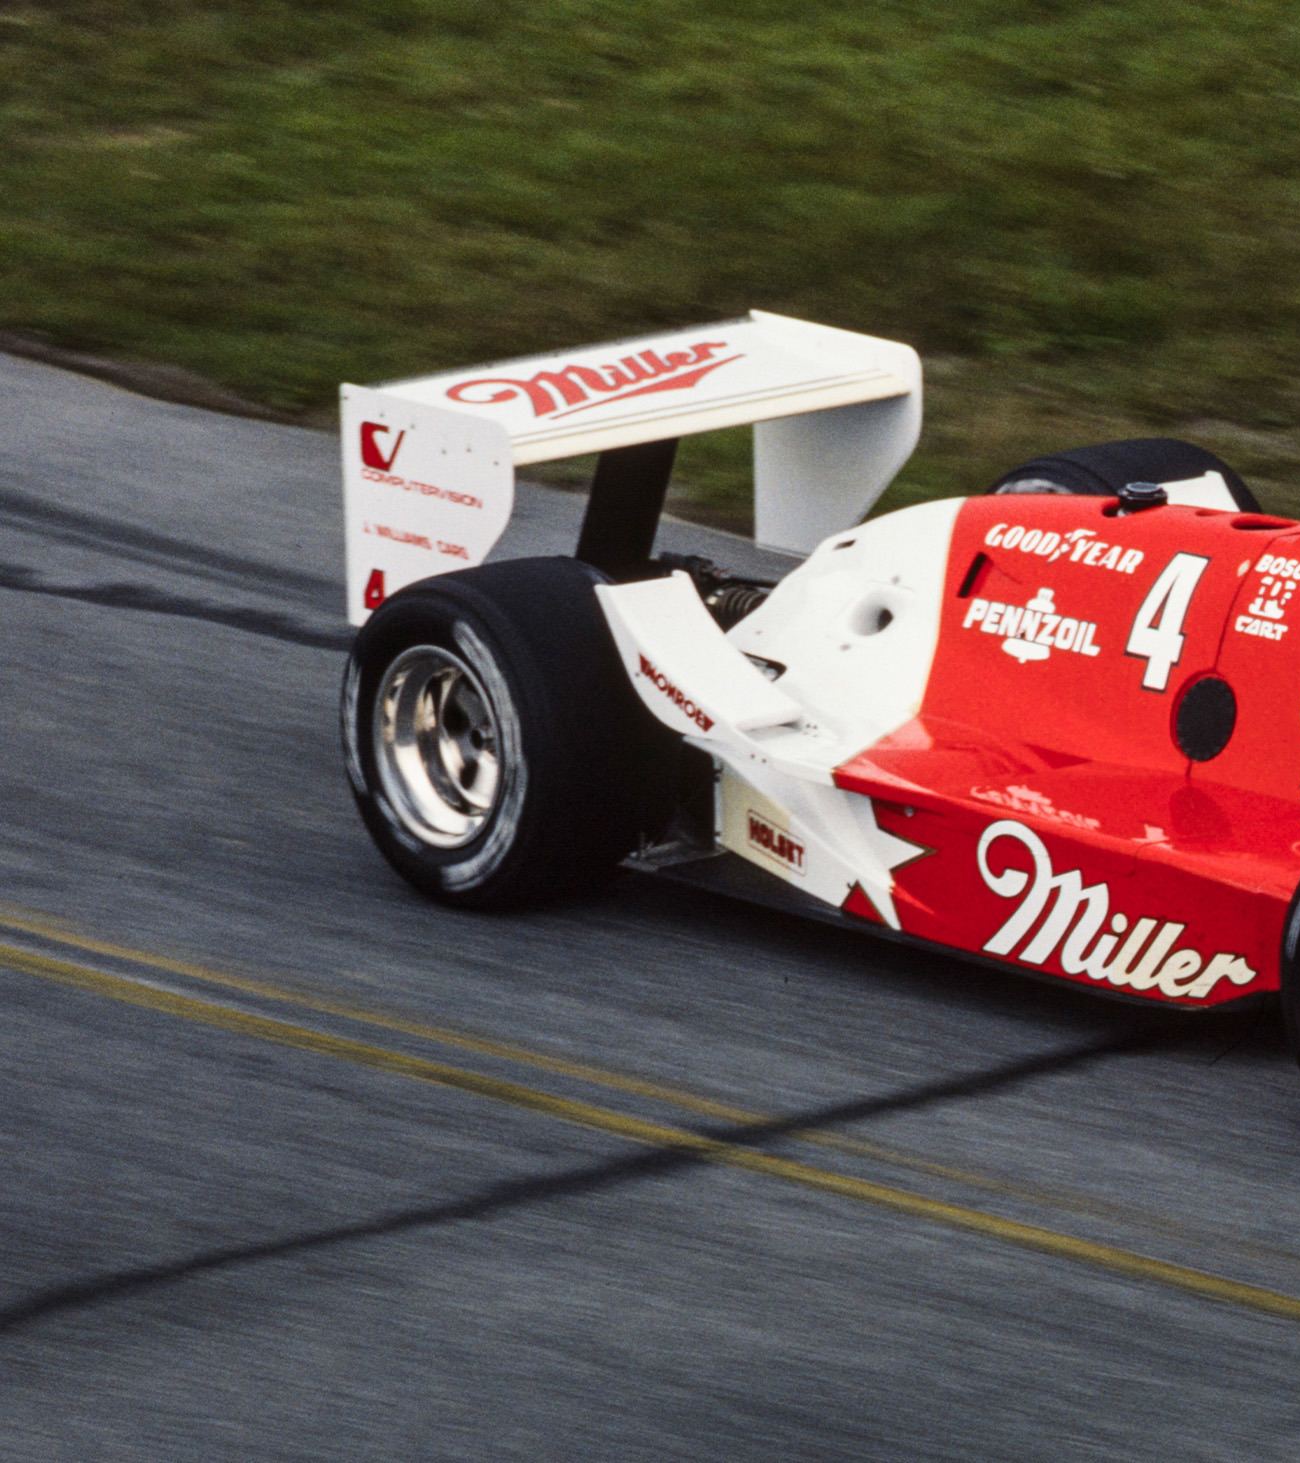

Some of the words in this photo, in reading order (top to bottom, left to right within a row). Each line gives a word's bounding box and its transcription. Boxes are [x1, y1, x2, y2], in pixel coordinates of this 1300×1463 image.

[446, 341, 728, 417] Miller
[362, 467, 483, 509] COMPUTERVISION
[984, 523, 1145, 574] GOODYEAR
[963, 598, 1101, 656] PENNZOIL
[1124, 551, 1212, 694] 4
[1235, 615, 1288, 641] CART
[977, 819, 1257, 998] Miller
